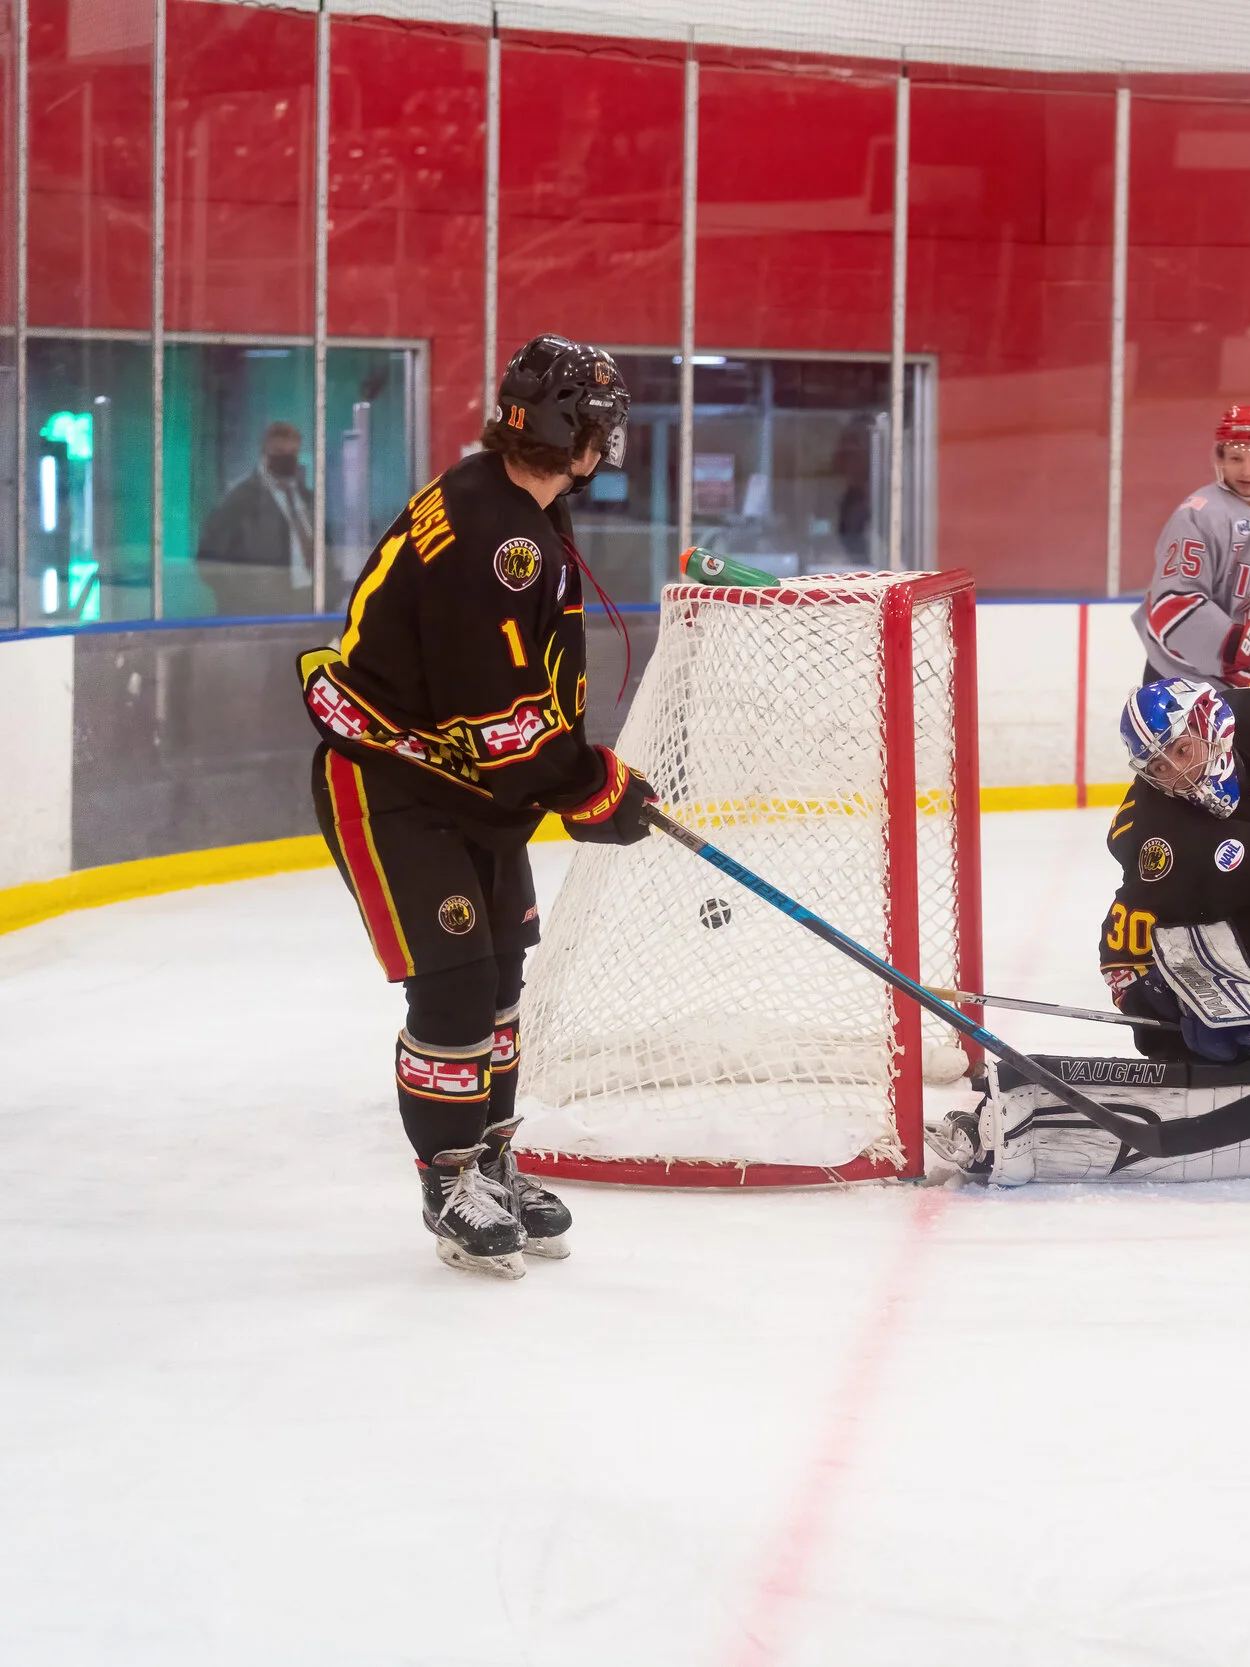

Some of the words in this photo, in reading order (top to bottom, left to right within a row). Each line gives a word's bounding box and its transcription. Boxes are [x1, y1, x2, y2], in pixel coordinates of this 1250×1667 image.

[508, 405, 525, 430] 11
[502, 540, 540, 561] MARYLAND
[1160, 538, 1206, 579] 25
[500, 617, 529, 668] 1
[1218, 841, 1242, 870] NAHL
[1106, 902, 1157, 956] 30
[1060, 1060, 1167, 1085] VAUGHN
